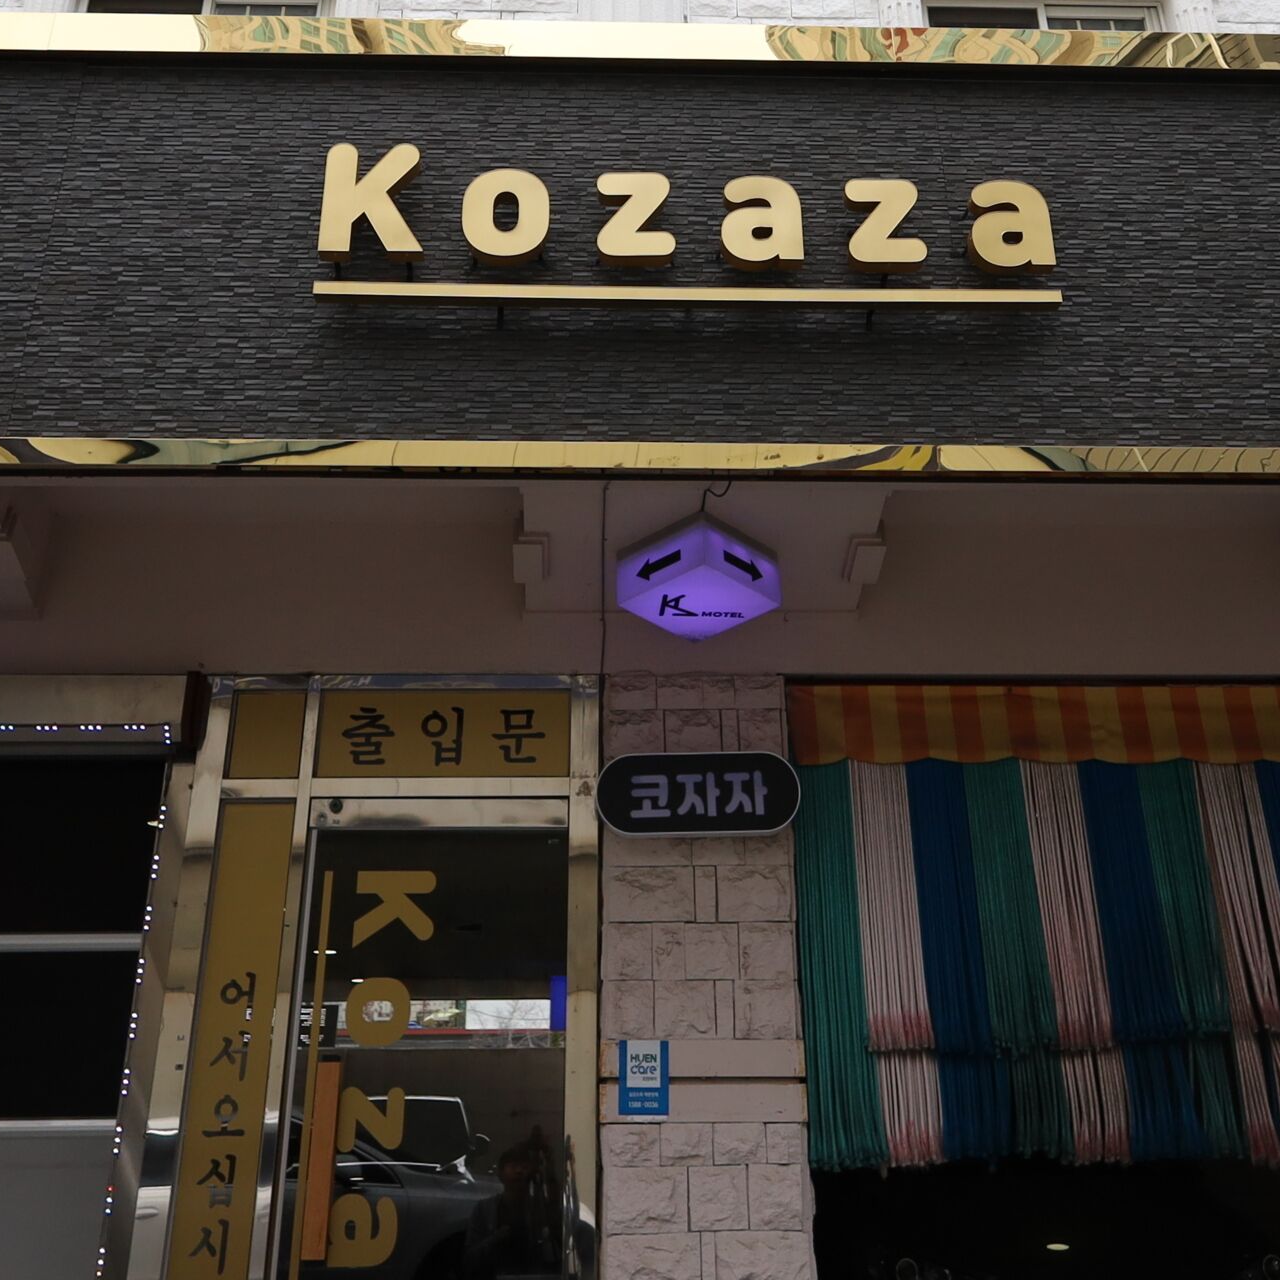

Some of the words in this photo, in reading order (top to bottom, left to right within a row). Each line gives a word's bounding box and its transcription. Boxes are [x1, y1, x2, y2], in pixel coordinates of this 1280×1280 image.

[318, 142, 1058, 272] Kozaza
[342, 707, 546, 767] 출입문
[630, 771, 768, 820] 코자자
